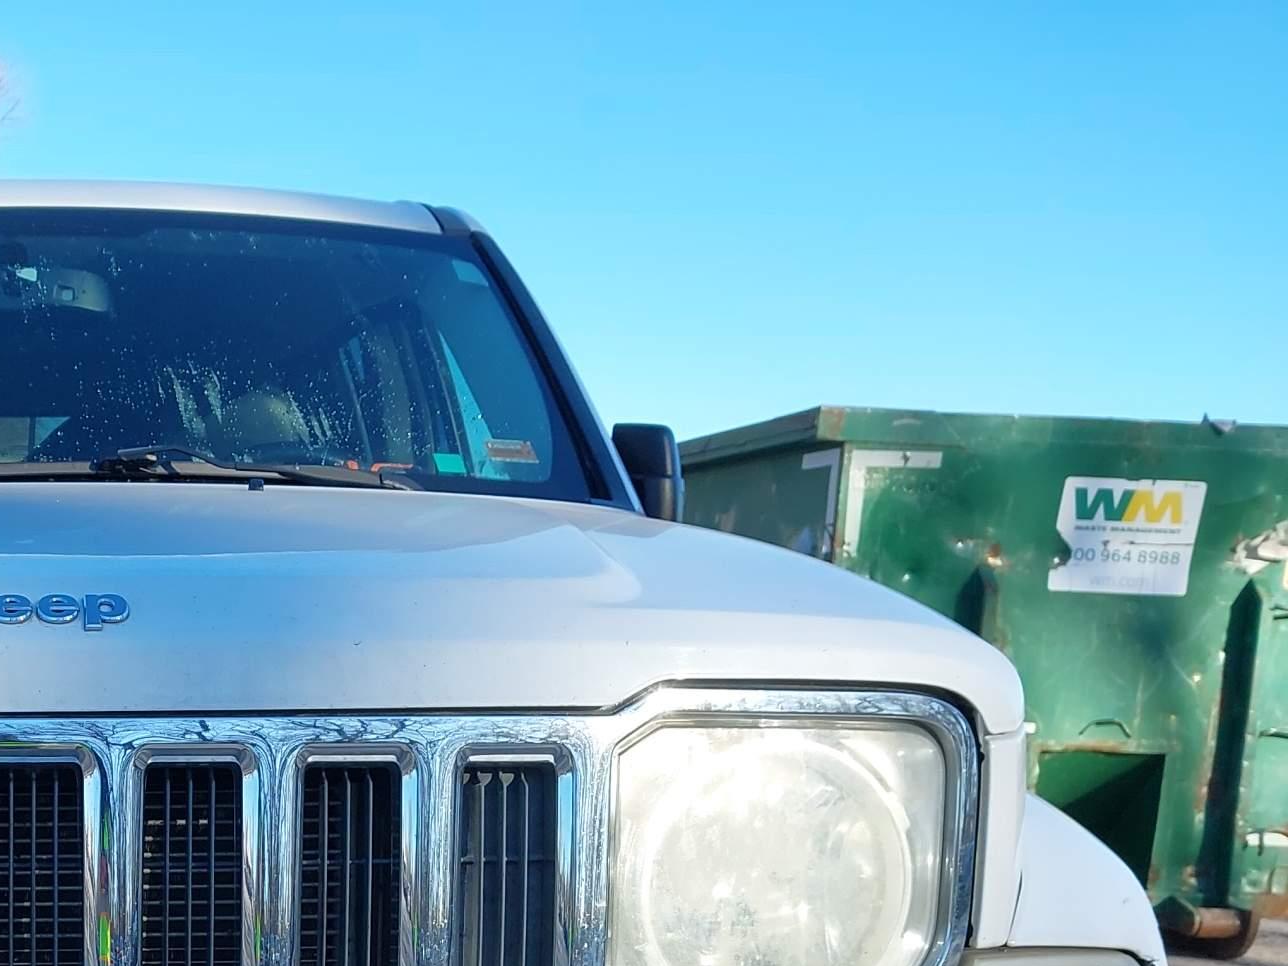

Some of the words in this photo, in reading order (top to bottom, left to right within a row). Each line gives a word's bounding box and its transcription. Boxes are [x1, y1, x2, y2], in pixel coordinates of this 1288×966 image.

[1074, 487, 1183, 524] WM
[1100, 548, 1131, 563] 964
[1137, 550, 1181, 565] 8988
